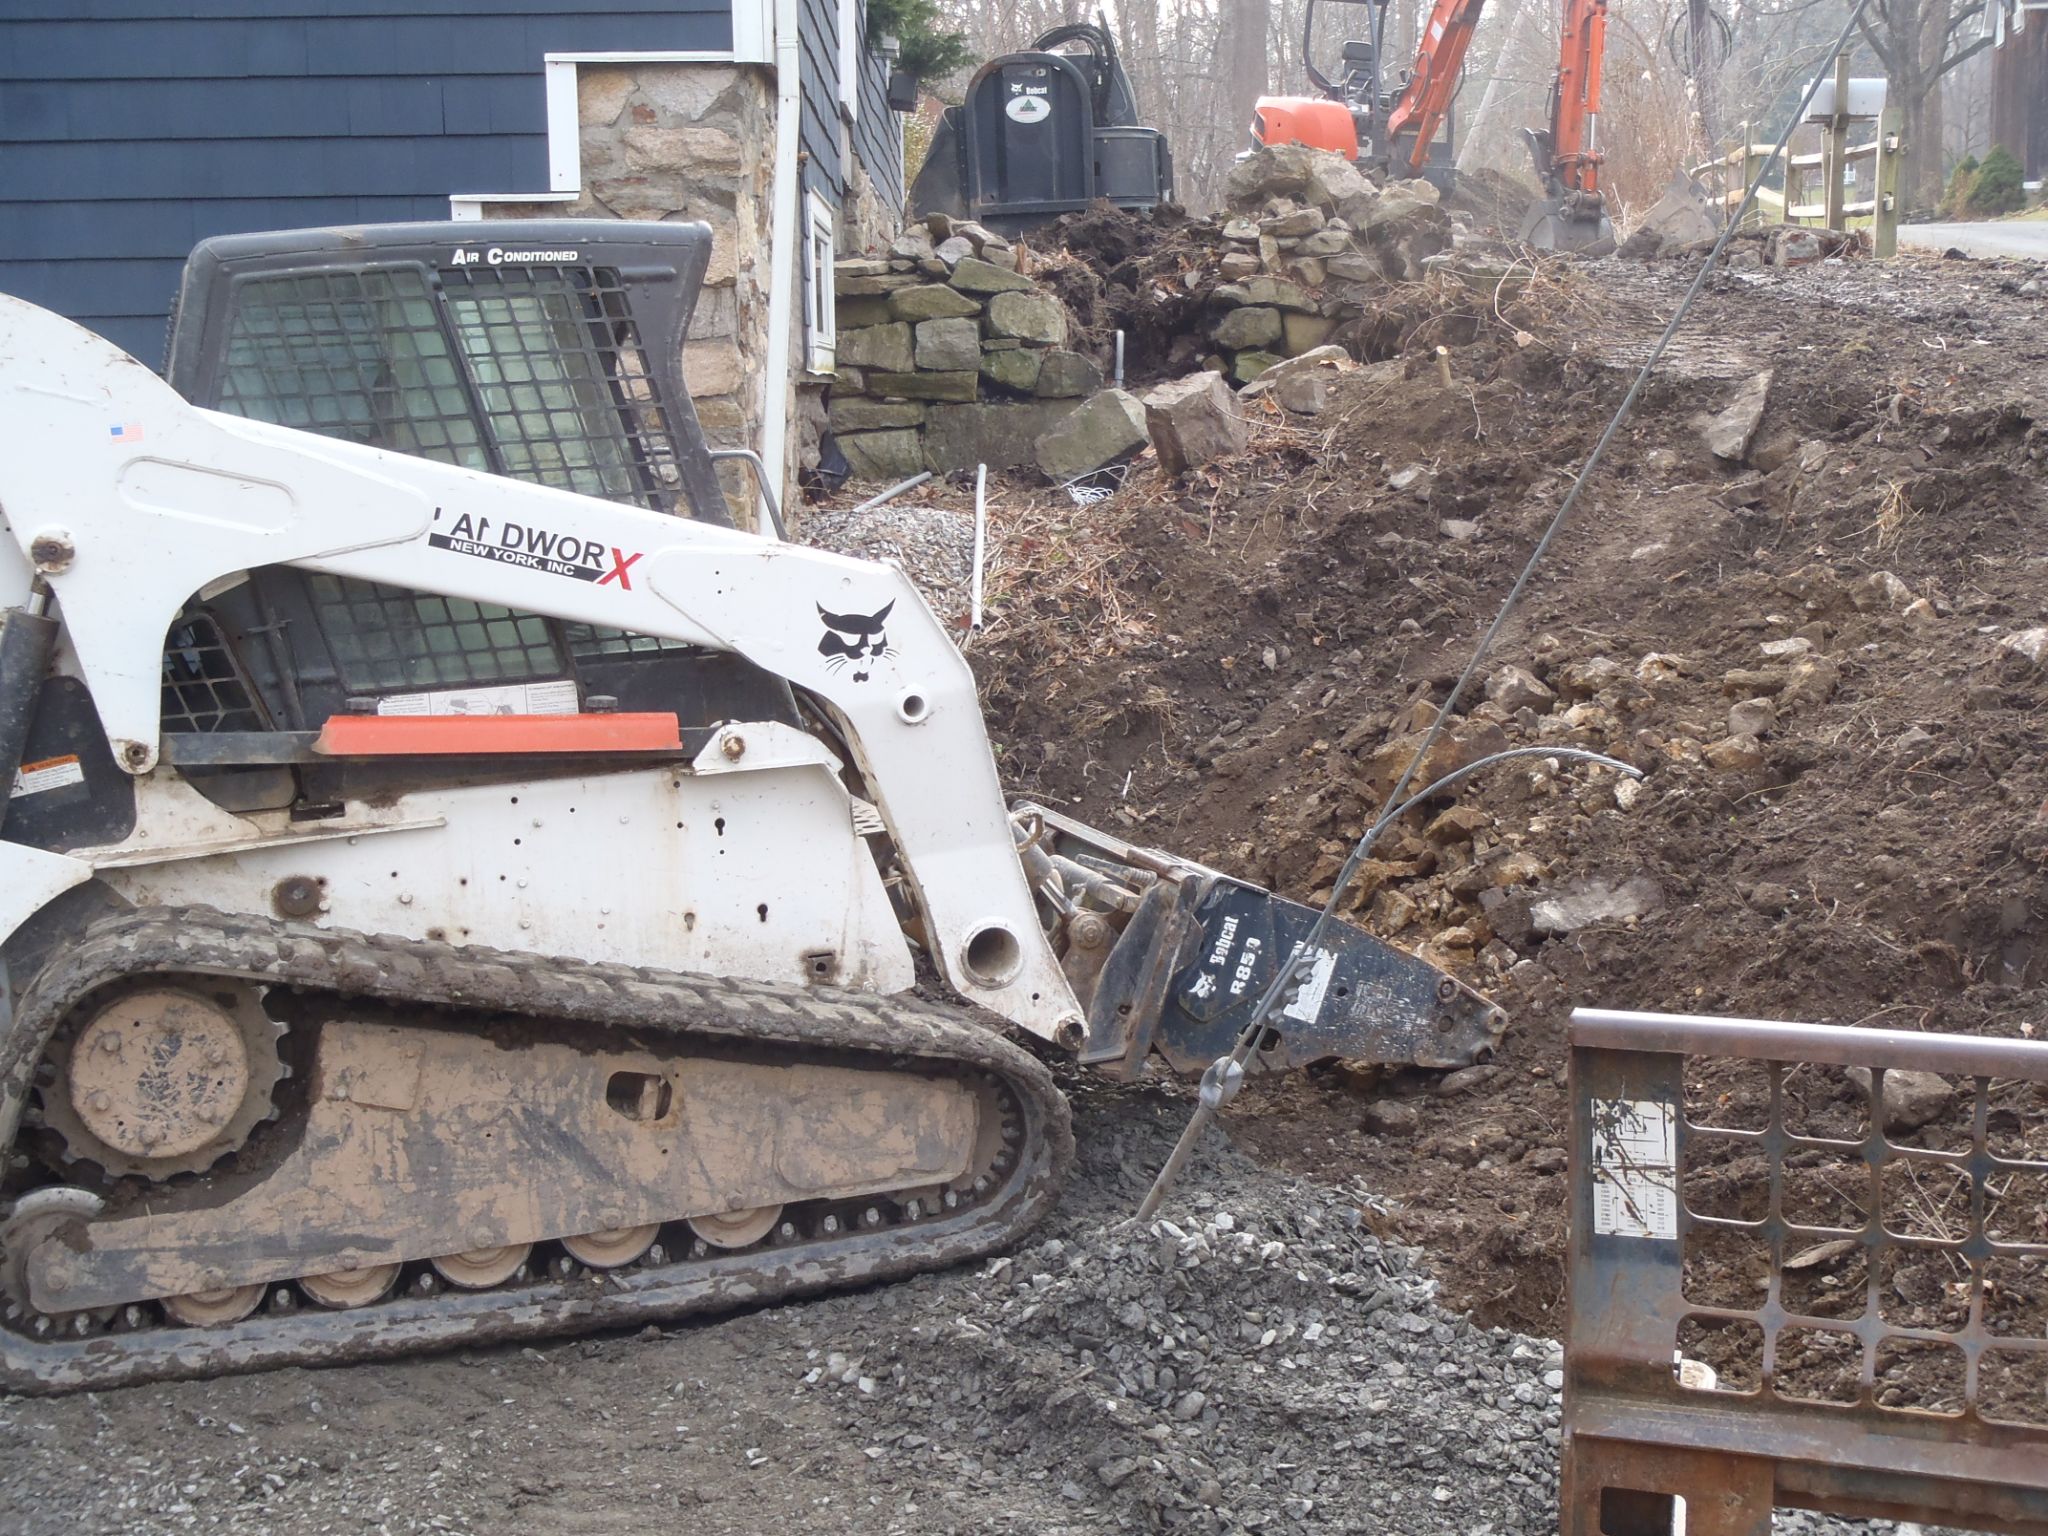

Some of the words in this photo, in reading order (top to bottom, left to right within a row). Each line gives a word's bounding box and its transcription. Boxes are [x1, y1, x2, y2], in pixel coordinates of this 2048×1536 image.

[433, 507, 644, 590] ADWORX
[450, 538, 494, 556] NEW
[492, 548, 543, 570] YORK,
[546, 560, 576, 576] INC
[1209, 916, 1239, 966] Bobcat
